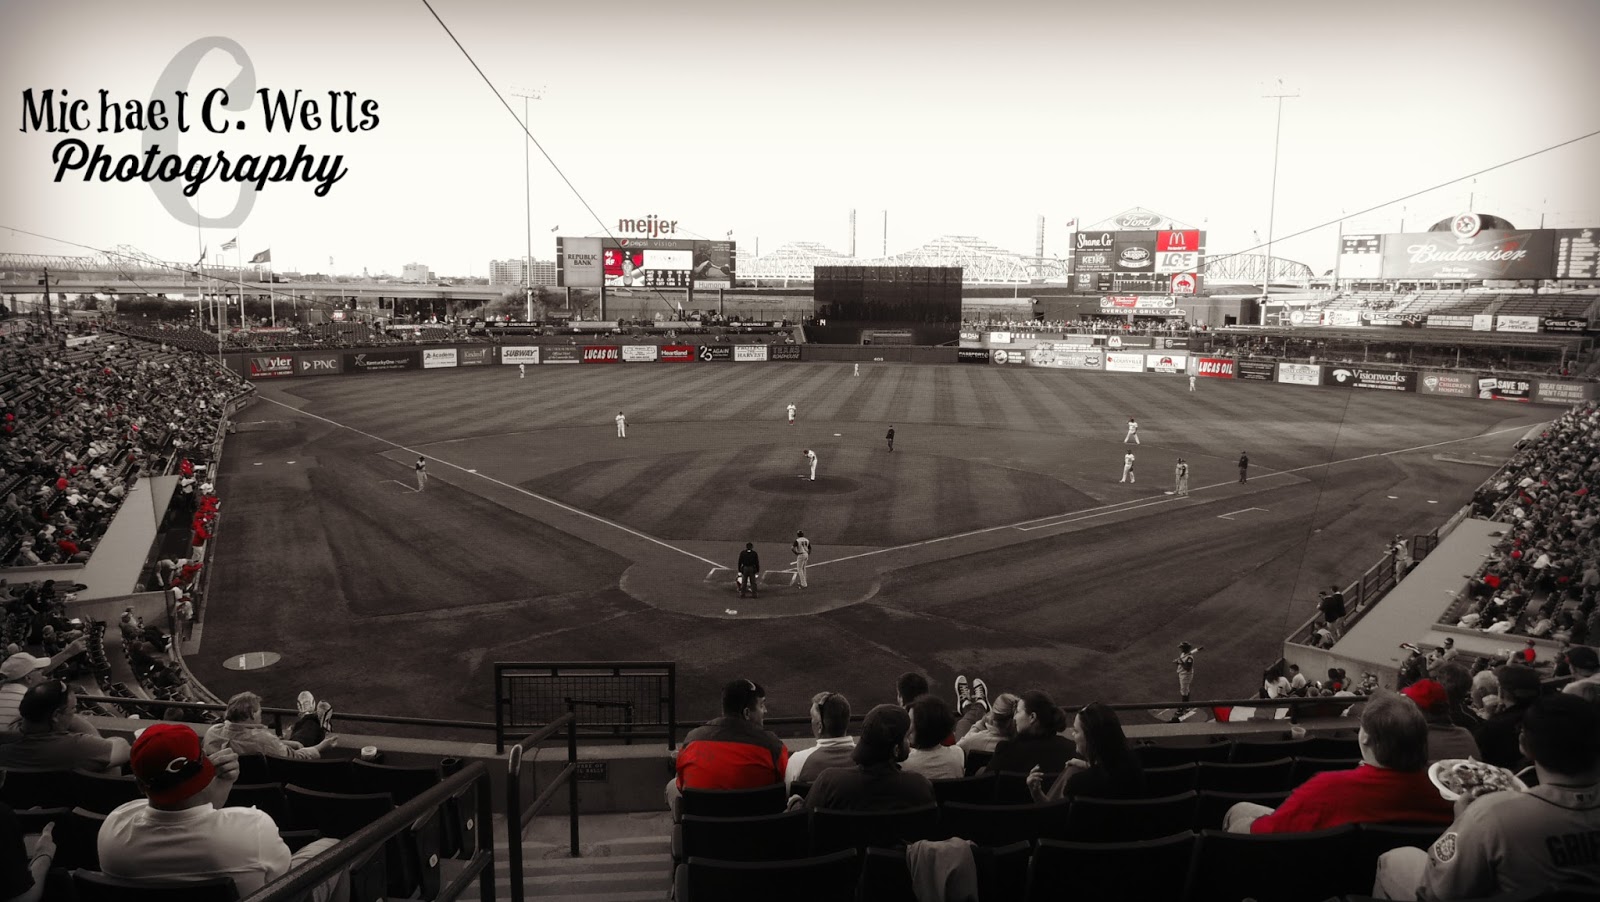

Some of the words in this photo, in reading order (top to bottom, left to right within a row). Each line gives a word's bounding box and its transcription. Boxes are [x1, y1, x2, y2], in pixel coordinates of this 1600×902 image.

[618, 214, 678, 237] meijer
[1122, 214, 1152, 226] Ford
[1077, 233, 1101, 248] Shane
[1407, 243, 1527, 263] Budweiser
[1082, 256, 1105, 265] KENO
[1544, 319, 1567, 327] Great
[1567, 319, 1587, 328] Clips
[503, 349, 537, 357] SUBWAY
[584, 349, 606, 359] LUCAS
[607, 349, 618, 359] OIL
[313, 360, 337, 369] PNC
[1198, 361, 1220, 373] LUCAS
[1221, 362, 1233, 374] OIL
[1352, 369, 1406, 382] Visionworks
[1497, 380, 1517, 389] SAVE
[165, 756, 188, 773] C
